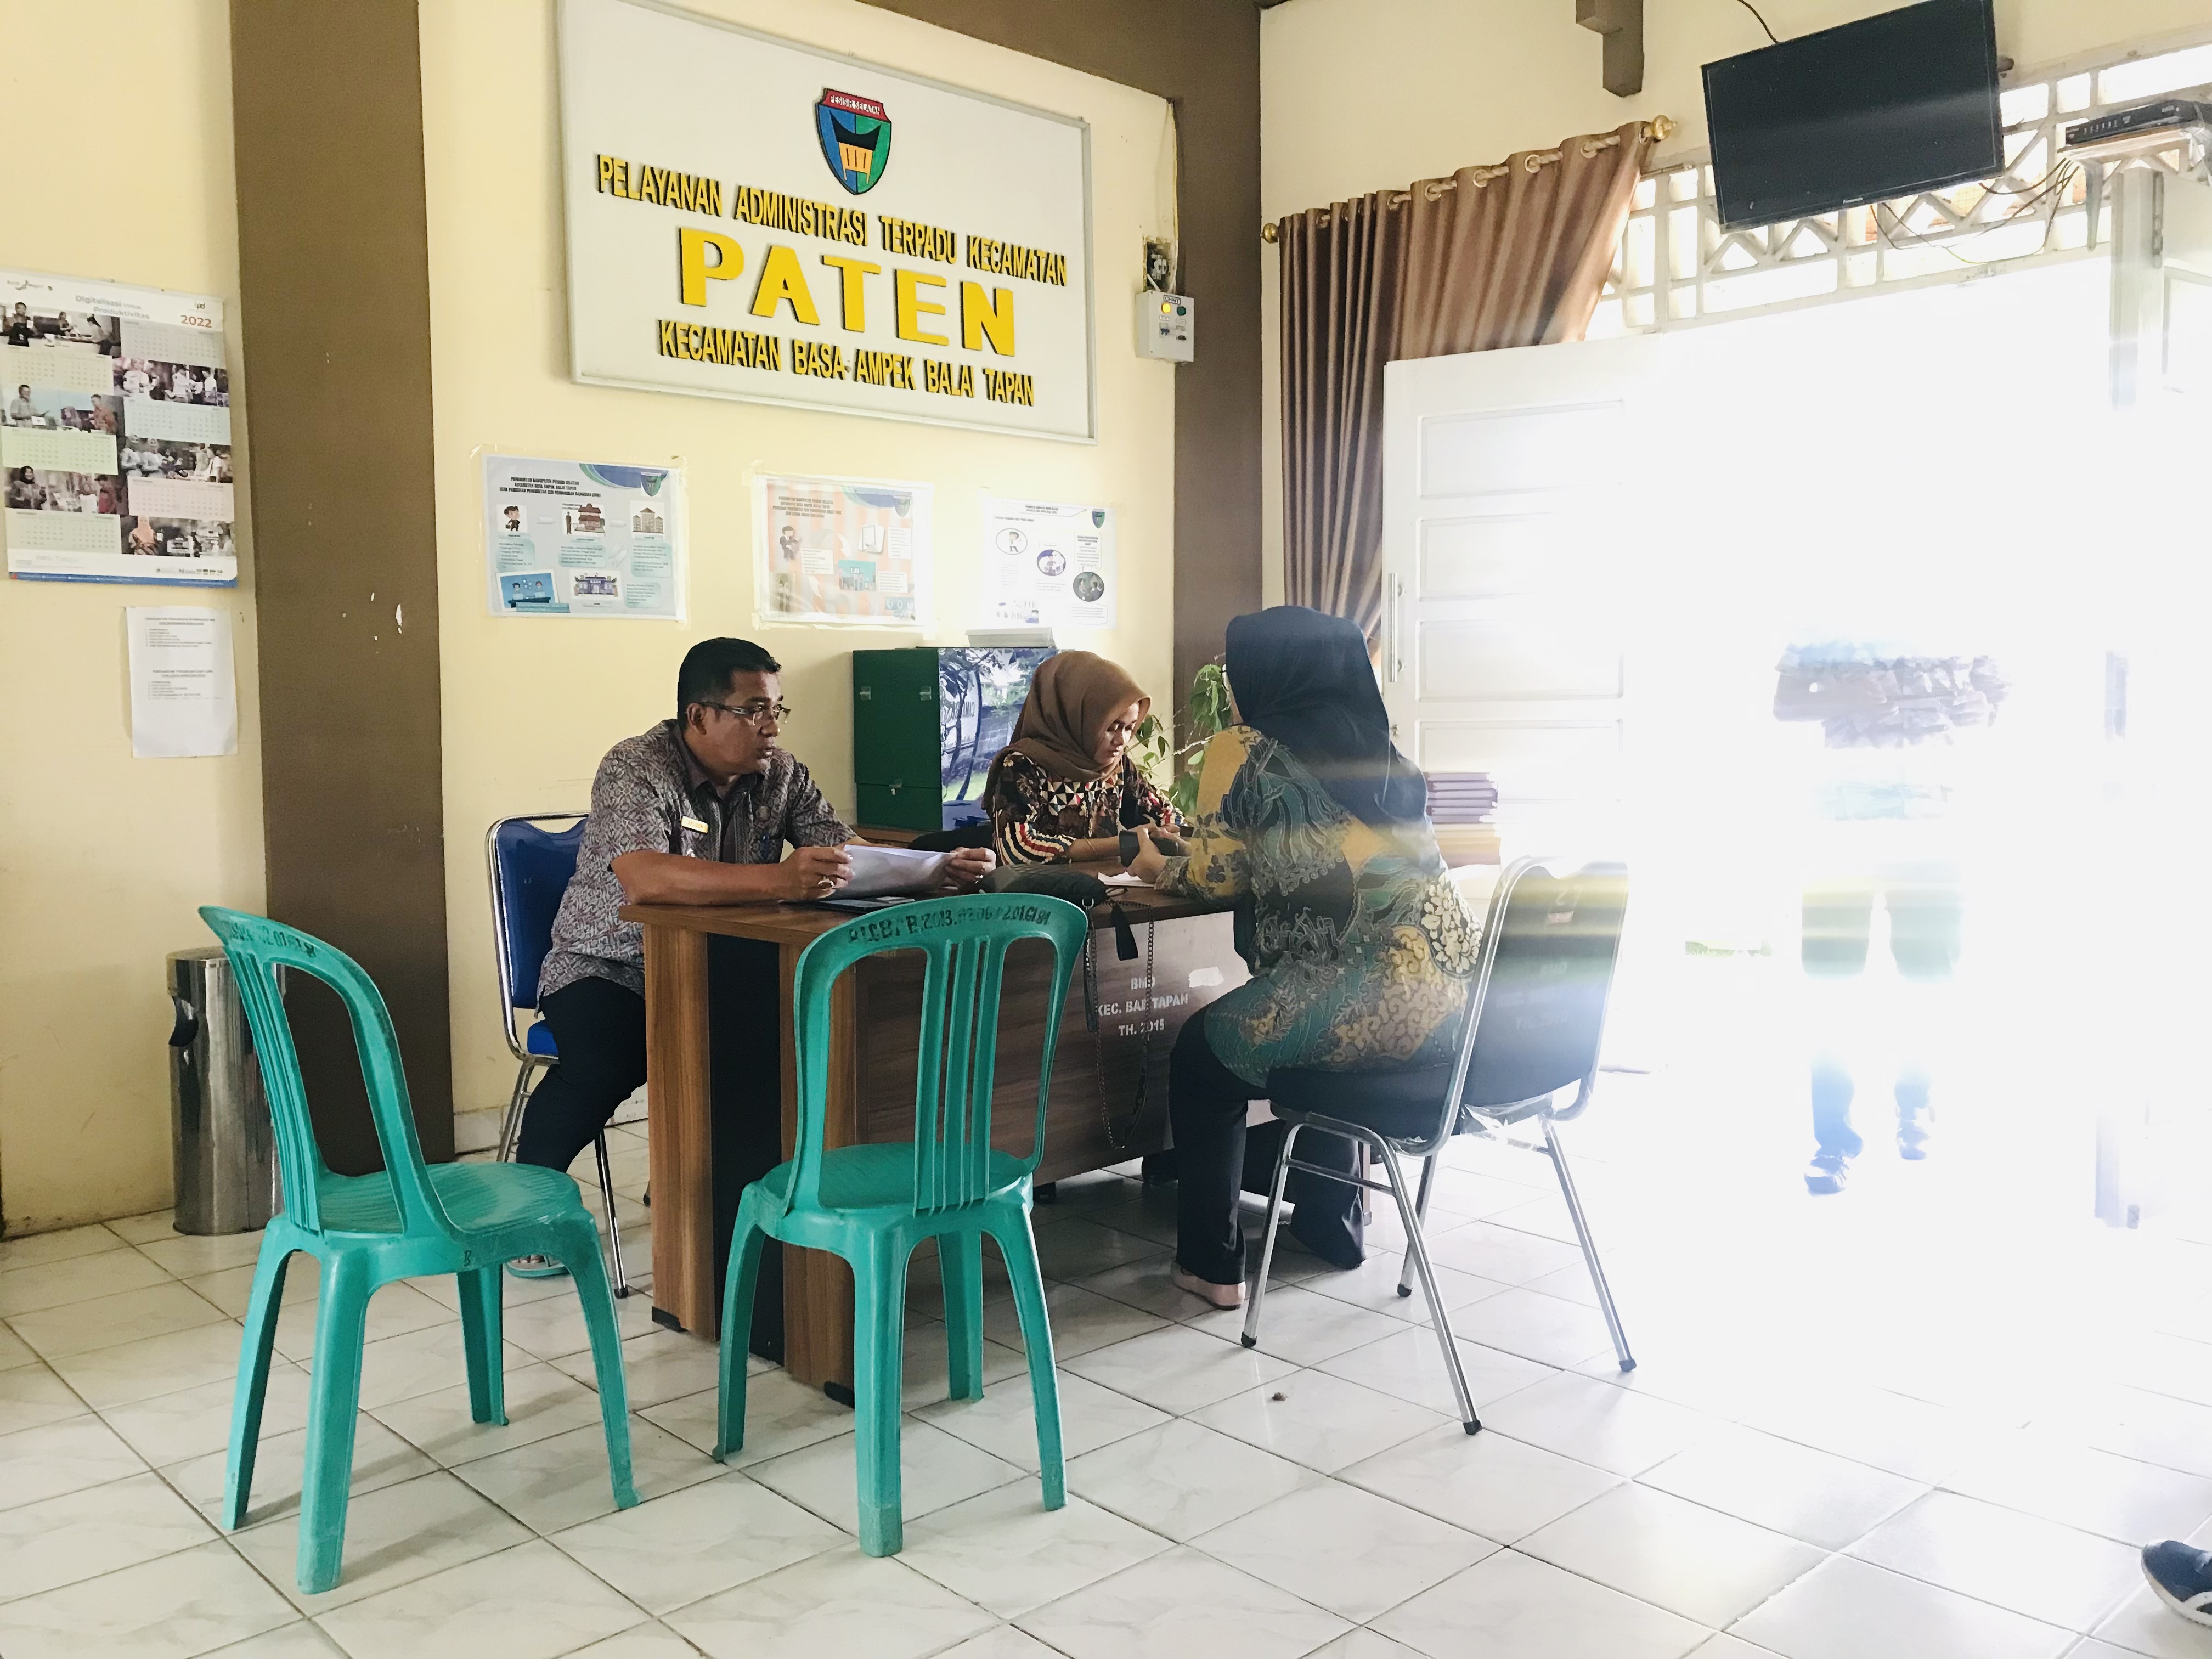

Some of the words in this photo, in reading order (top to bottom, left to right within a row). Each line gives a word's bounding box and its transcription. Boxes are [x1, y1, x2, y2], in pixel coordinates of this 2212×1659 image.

[597, 155, 723, 217] PELAYANAN
[733, 186, 868, 246] ADMINISTRASI
[878, 216, 957, 264] TERPADU
[967, 236, 1066, 286] KECAMATAN
[679, 227, 1015, 357] PATEN
[180, 315, 212, 328] 2022
[658, 320, 781, 371] KECAMATAN
[792, 340, 847, 380] BASA
[853, 349, 917, 390] AMPEK
[924, 359, 974, 398] BALAI
[983, 369, 1035, 407] TAPAN
[1152, 993, 1188, 1009] TAPAN
[1118, 1024, 1137, 1036] TH.
